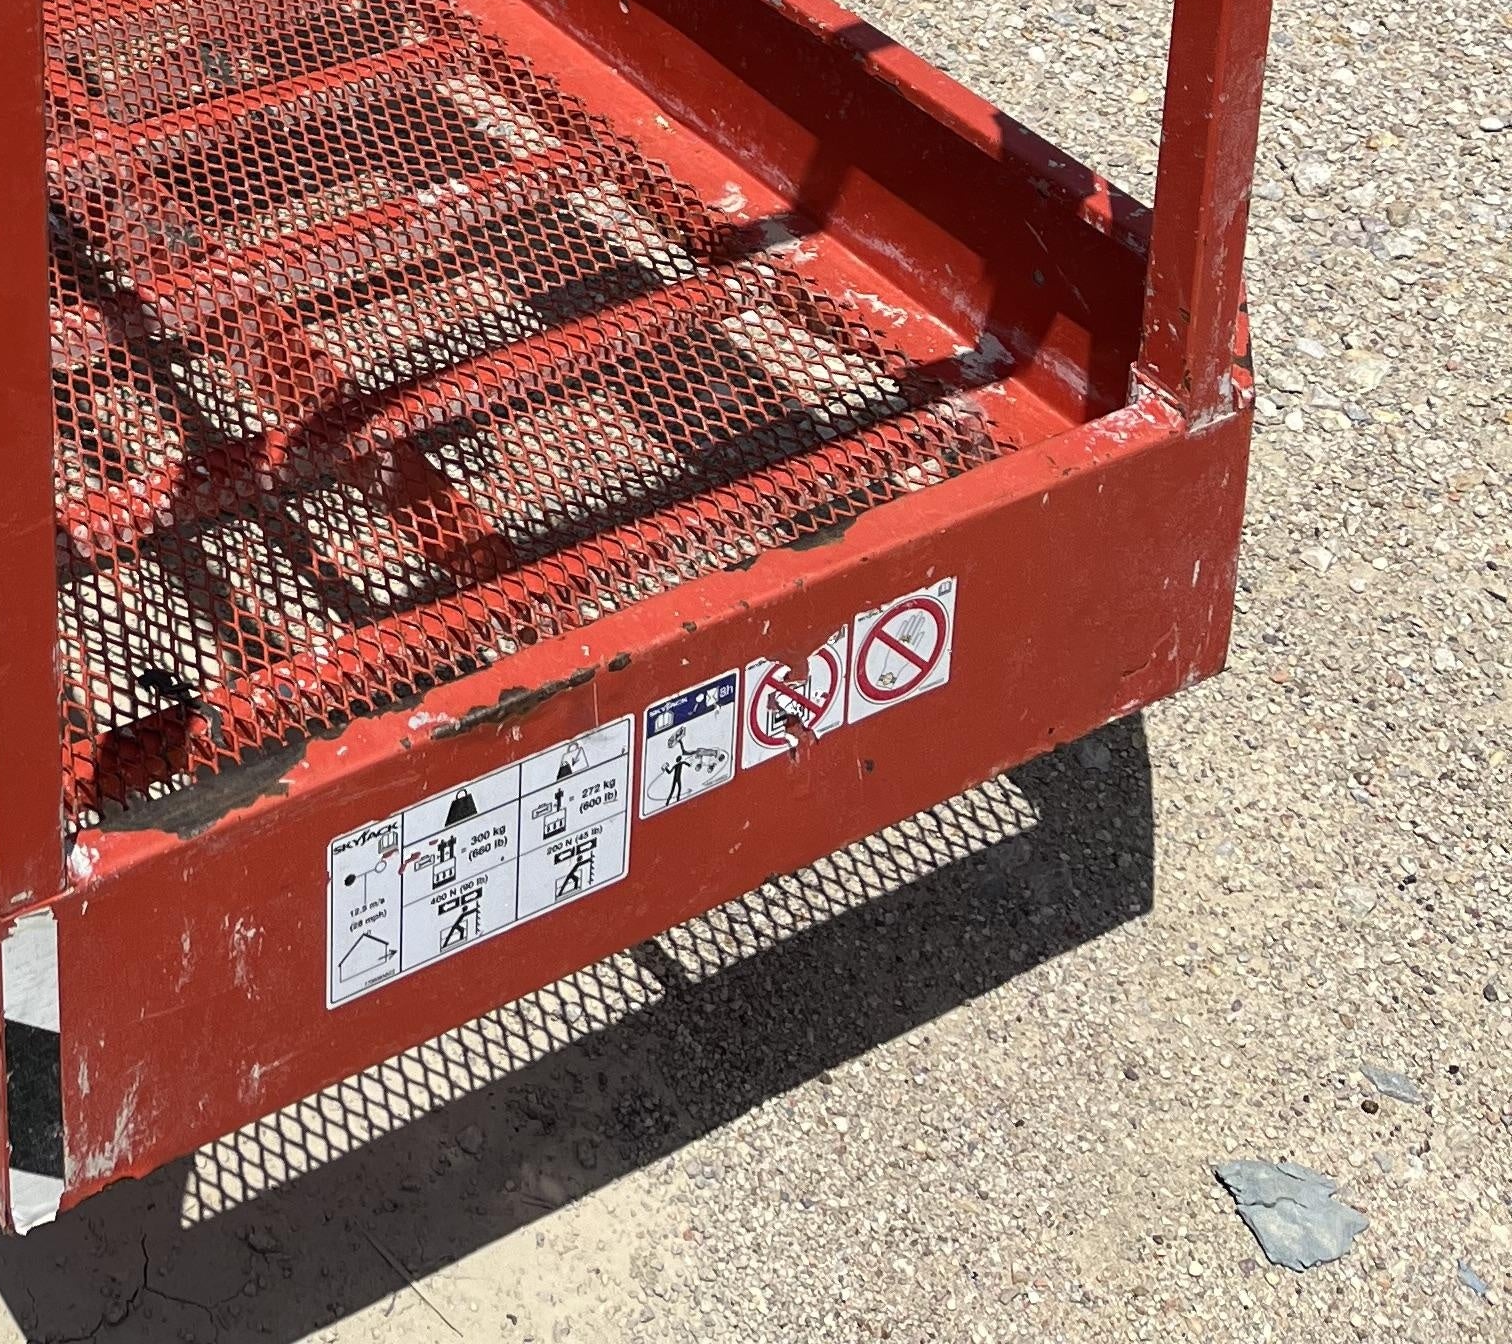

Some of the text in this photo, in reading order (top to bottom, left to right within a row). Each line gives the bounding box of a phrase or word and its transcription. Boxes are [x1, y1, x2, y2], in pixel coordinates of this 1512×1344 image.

[581, 778, 616, 799] 272 kg
[579, 789, 618, 814] (600 lb)
[333, 821, 398, 855] SKYJACK
[470, 824, 506, 846] 300 kg
[565, 837, 573, 846] N
[468, 836, 508, 862] (660 lb)
[449, 887, 457, 897] N
